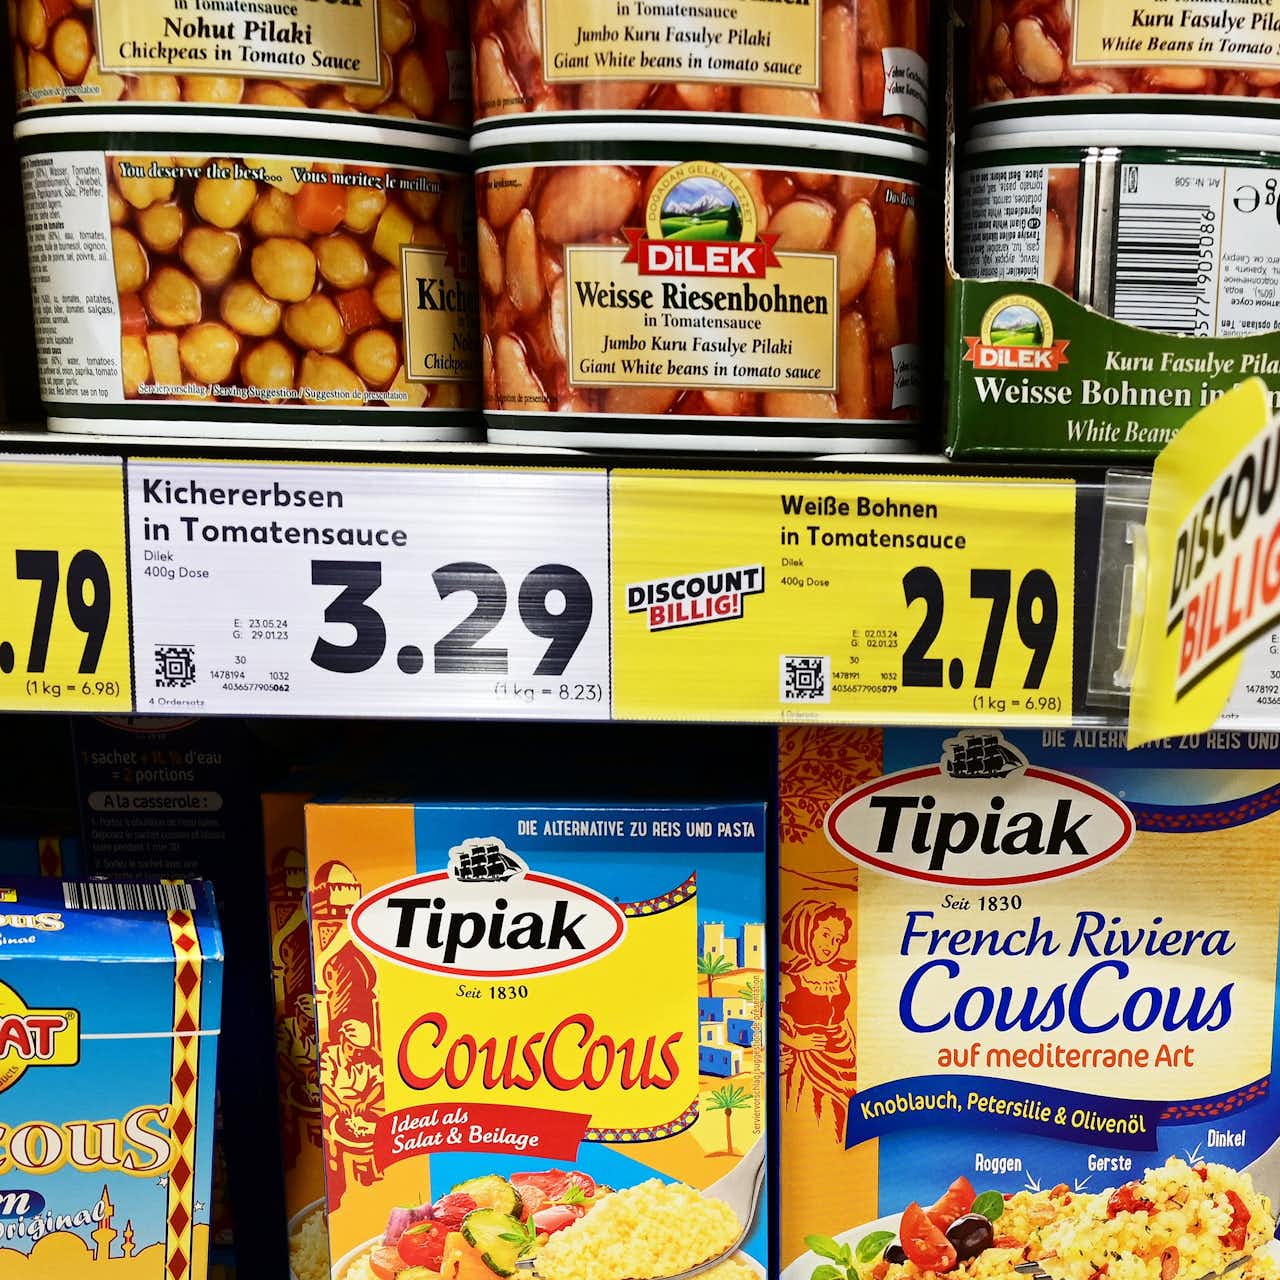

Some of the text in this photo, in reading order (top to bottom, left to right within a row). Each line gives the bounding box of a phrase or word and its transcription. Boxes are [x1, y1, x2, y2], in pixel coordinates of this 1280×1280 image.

[164, 18, 312, 45] Nohut Pilaki
[119, 42, 360, 71] Chickpeas in Tomato Sauce
[119, 162, 396, 190] You deserve the best... Vous meritez le
[575, 281, 827, 314] Weisse Riesenbohnen
[644, 314, 761, 330] in Tomatensauce
[580, 359, 820, 379] Giant White beans in tomato sauce
[976, 377, 1191, 407] Weisse Bohnen
[144, 480, 344, 508] Kichererbsen
[782, 495, 938, 518] Weiße Bohnen
[144, 551, 173, 562] Dilek
[144, 567, 209, 580] 400g Dose
[628, 569, 758, 608] DISCOUNT
[310, 560, 593, 676] 3.29
[649, 596, 739, 625] BILLIG!
[902, 566, 1058, 689] 2.79
[517, 820, 755, 838] DIE ALTERNATIVE ZU REIS UND PASTA
[869, 796, 1095, 870] Tipiak
[941, 894, 1021, 912] Seit 1830
[900, 911, 1235, 957] French Riviera
[899, 960, 1235, 1034] CousCous
[938, 1043, 1195, 1068] auf mediterrane Art
[391, 1110, 468, 1135] Ideal als
[861, 1092, 1146, 1133] Knoblauch, Petersilie & Olivenöl
[392, 1126, 539, 1154] Salat & Beilage
[1207, 1129, 1246, 1147] Dinkel
[975, 1154, 1021, 1173] Roggen
[1088, 1154, 1132, 1171] Gerste
